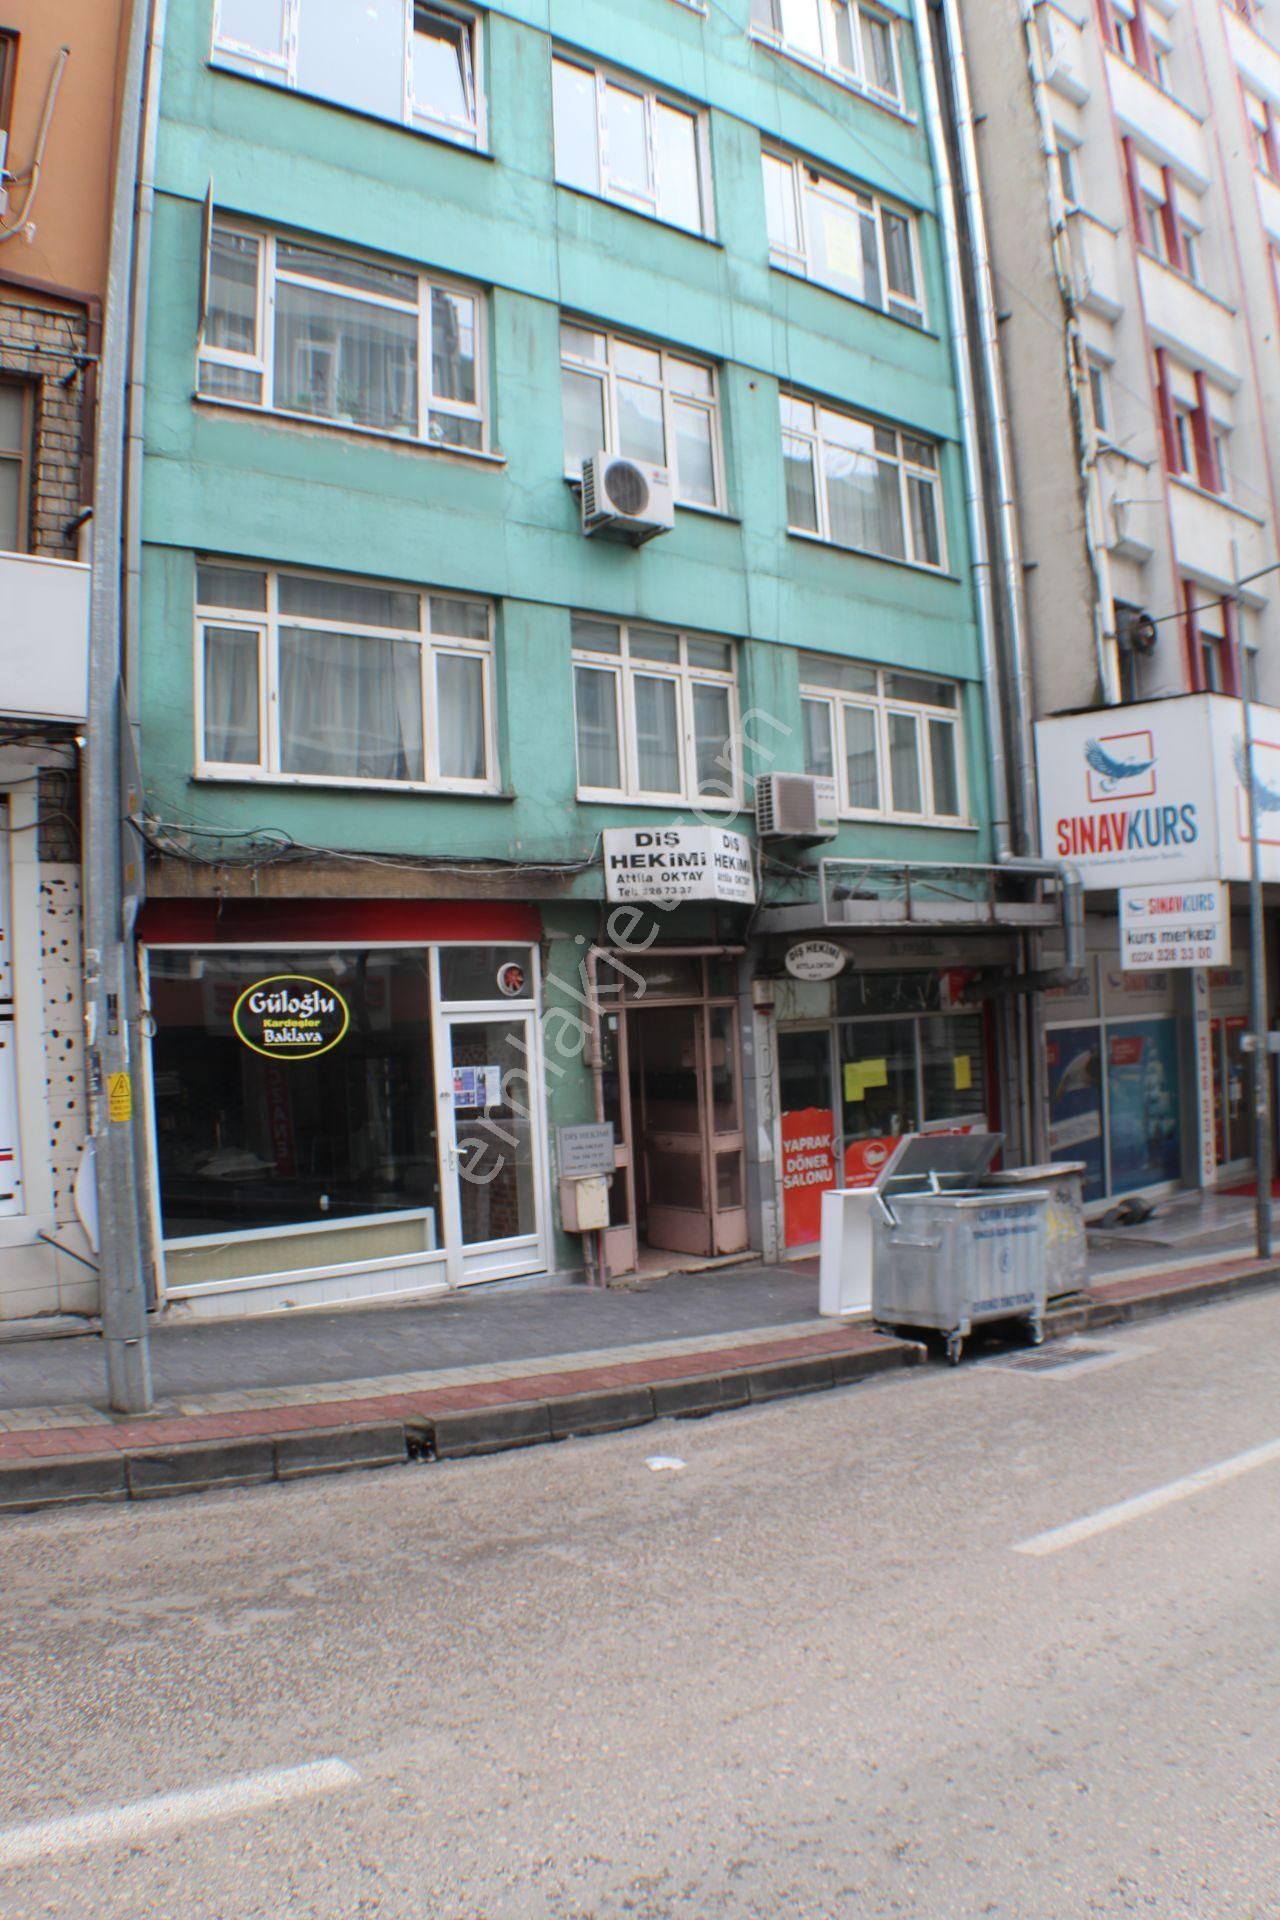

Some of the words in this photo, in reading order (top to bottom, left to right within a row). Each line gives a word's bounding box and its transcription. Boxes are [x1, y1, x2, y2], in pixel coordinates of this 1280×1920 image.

[1056, 803, 1199, 856] SINAVKURS
[661, 871, 704, 882] OKTAY
[1148, 893, 1215, 915] SINAVKURS
[1127, 927, 1156, 945] kurs
[1162, 923, 1216, 943] merkezi
[248, 989, 335, 1018] Güloğlu
[263, 1019, 321, 1029] Kardeşler
[263, 1027, 323, 1043] Baklava
[783, 1134, 831, 1153] YAPRAK
[786, 1153, 829, 1173] DÖNER
[783, 1168, 833, 1189] SALONU
